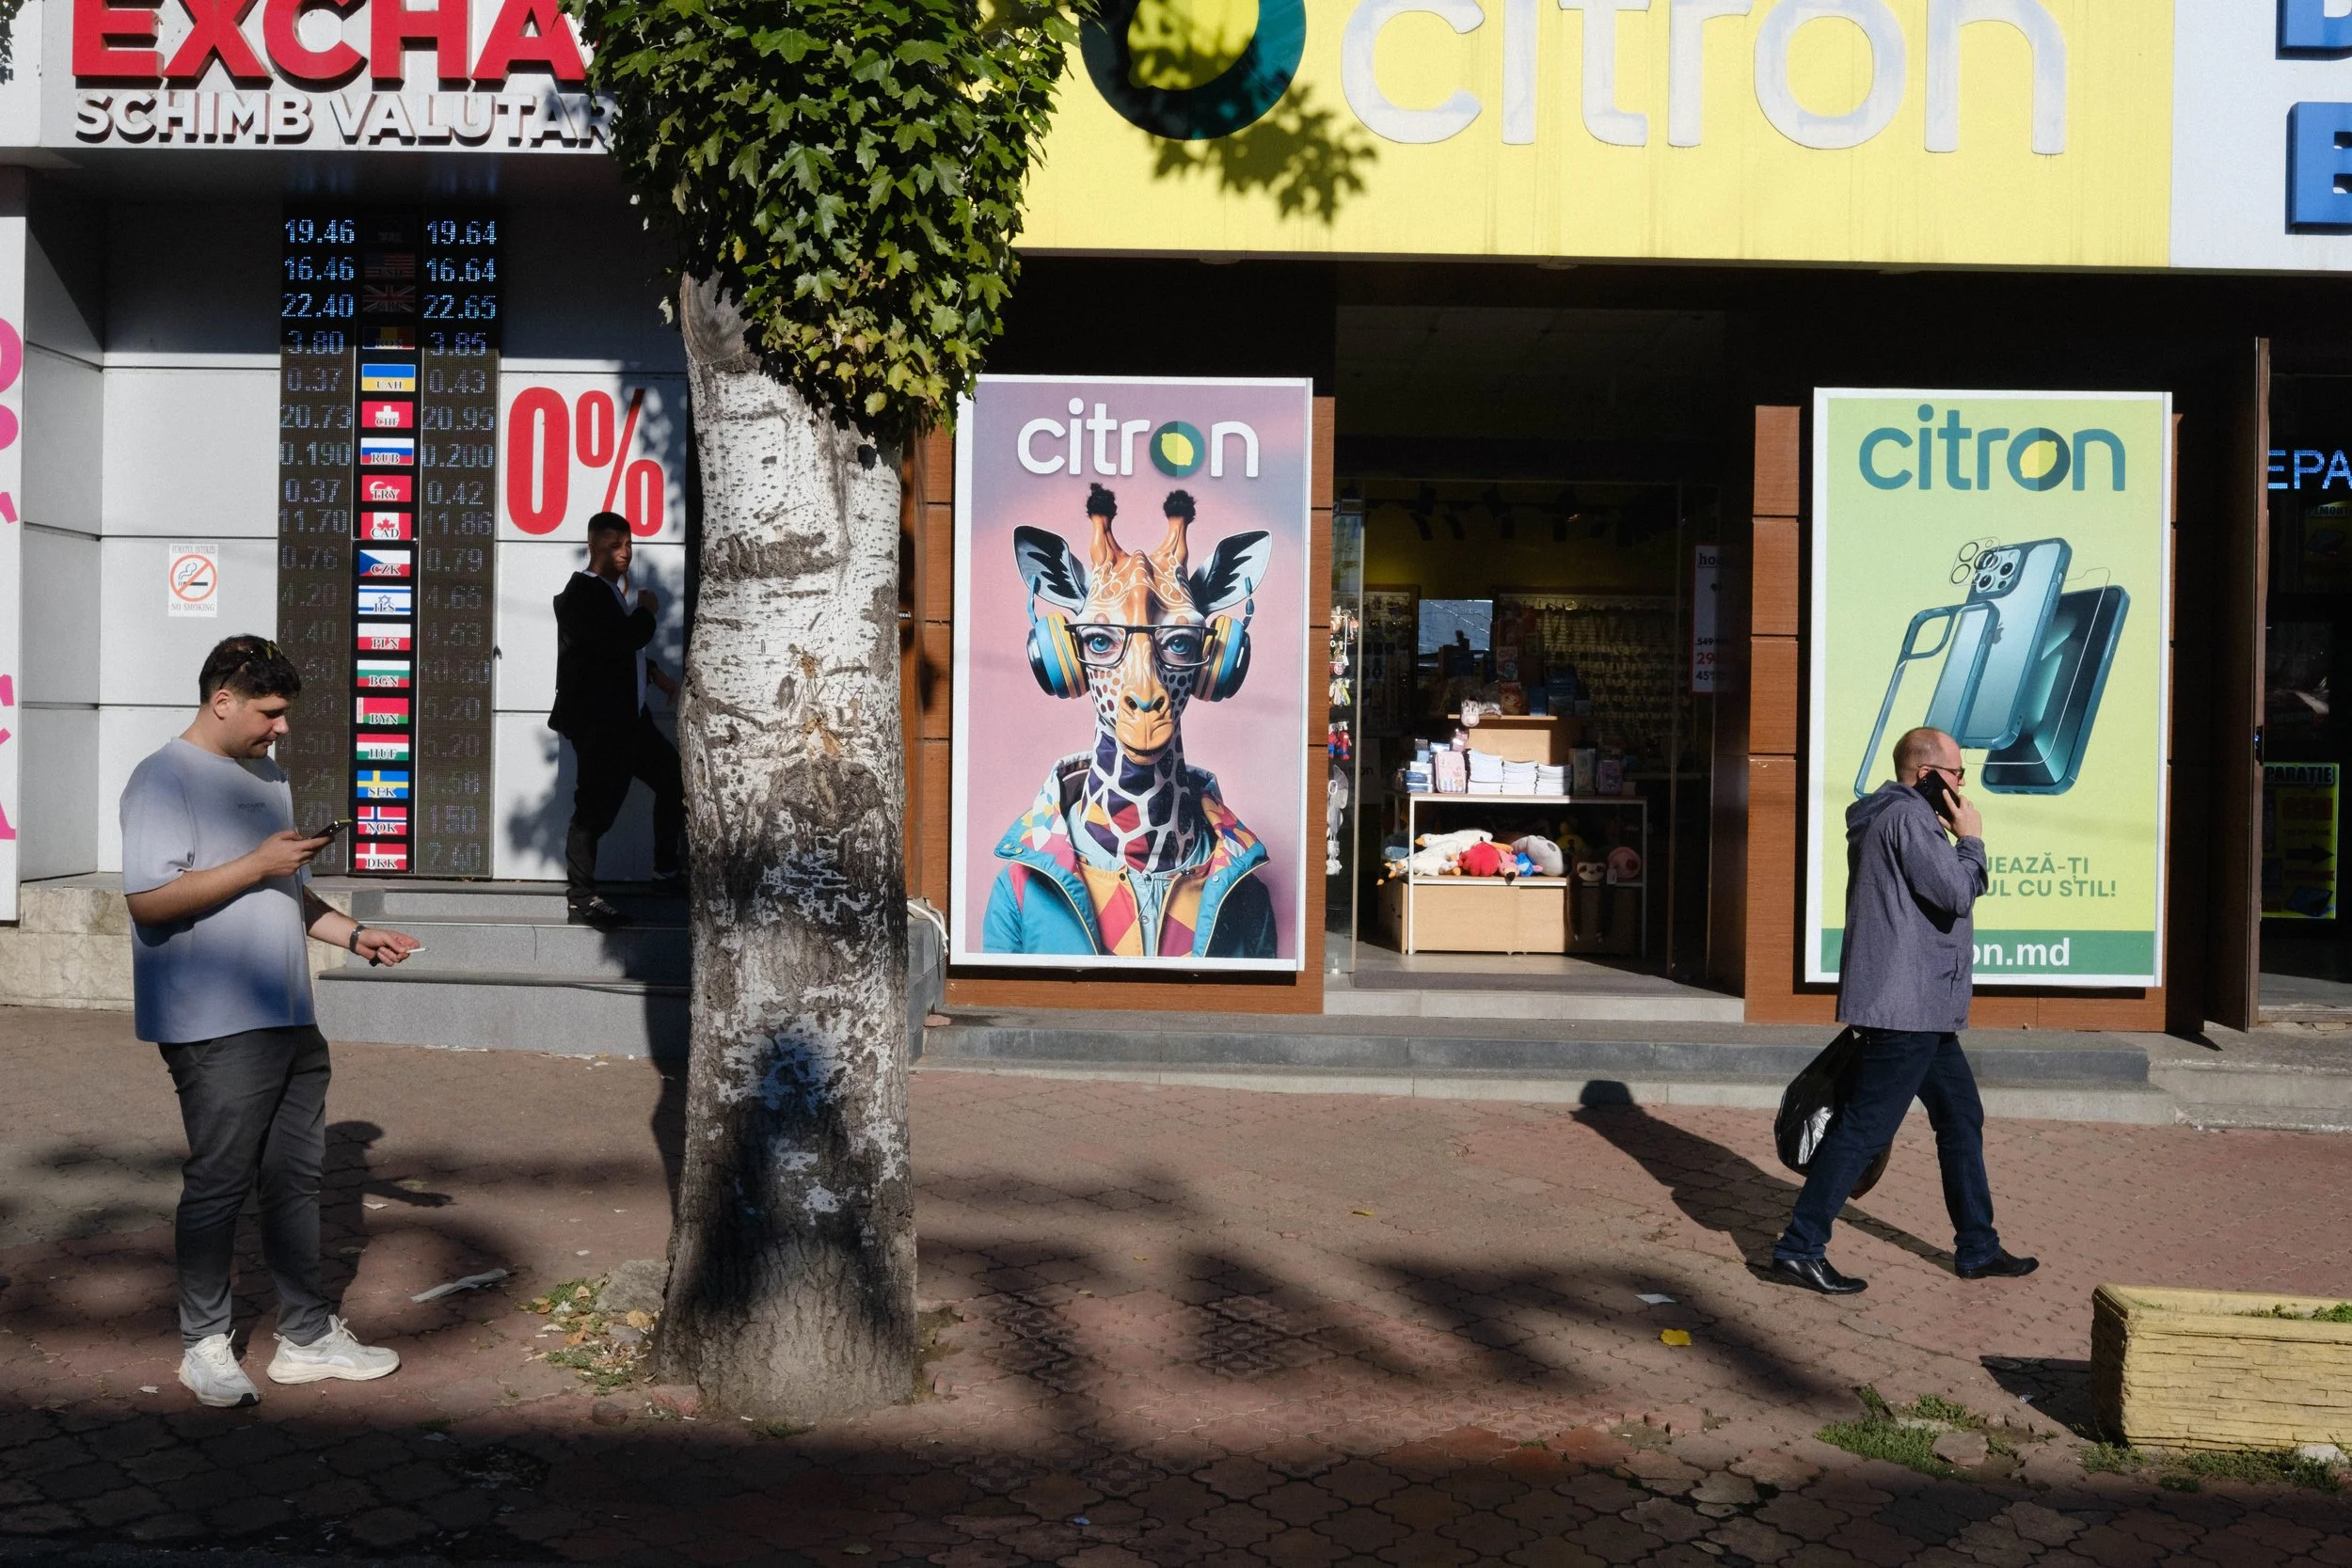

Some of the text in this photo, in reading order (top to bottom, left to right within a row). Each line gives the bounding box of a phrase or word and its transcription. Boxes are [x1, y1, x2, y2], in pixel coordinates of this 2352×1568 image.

[75, 92, 613, 144] SCHIMB VALUTAR
[285, 219, 355, 244] 19.46
[427, 220, 497, 245] 19.64
[284, 256, 354, 280] 16.46
[425, 258, 496, 282] 16.64
[281, 293, 354, 318] 22.40
[423, 295, 496, 319] 22.65
[288, 330, 344, 355] 3.80
[429, 332, 486, 356] 3.85
[287, 368, 486, 393] 0.37 UAH 0.43
[280, 404, 495, 430] 20.73 CHF 20.95
[1018, 398, 1259, 478] citron
[1859, 404, 2126, 491] citron
[281, 442, 494, 467] 0.190 RUB 0.200
[507, 387, 664, 537] 0%
[285, 479, 484, 505] 0.37 TRY 0.42
[279, 508, 493, 538] 11.70 CAD 11.86
[281, 546, 483, 574] 0.76 CZK 0.79
[183, 603, 215, 611] SMOKING
[281, 583, 482, 612] 4.20 ILS 4.65
[280, 620, 482, 648] 4.40 PLN 4.53
[369, 675, 399, 686] BGN
[370, 715, 398, 724] BYN
[369, 749, 396, 759] HUF
[424, 734, 480, 757] 5.20
[368, 787, 395, 797] SEK
[368, 823, 396, 832] NOK
[367, 858, 395, 868] DKK
[2018, 879, 2052, 897] CU
[2059, 879, 2117, 897] STIL!
